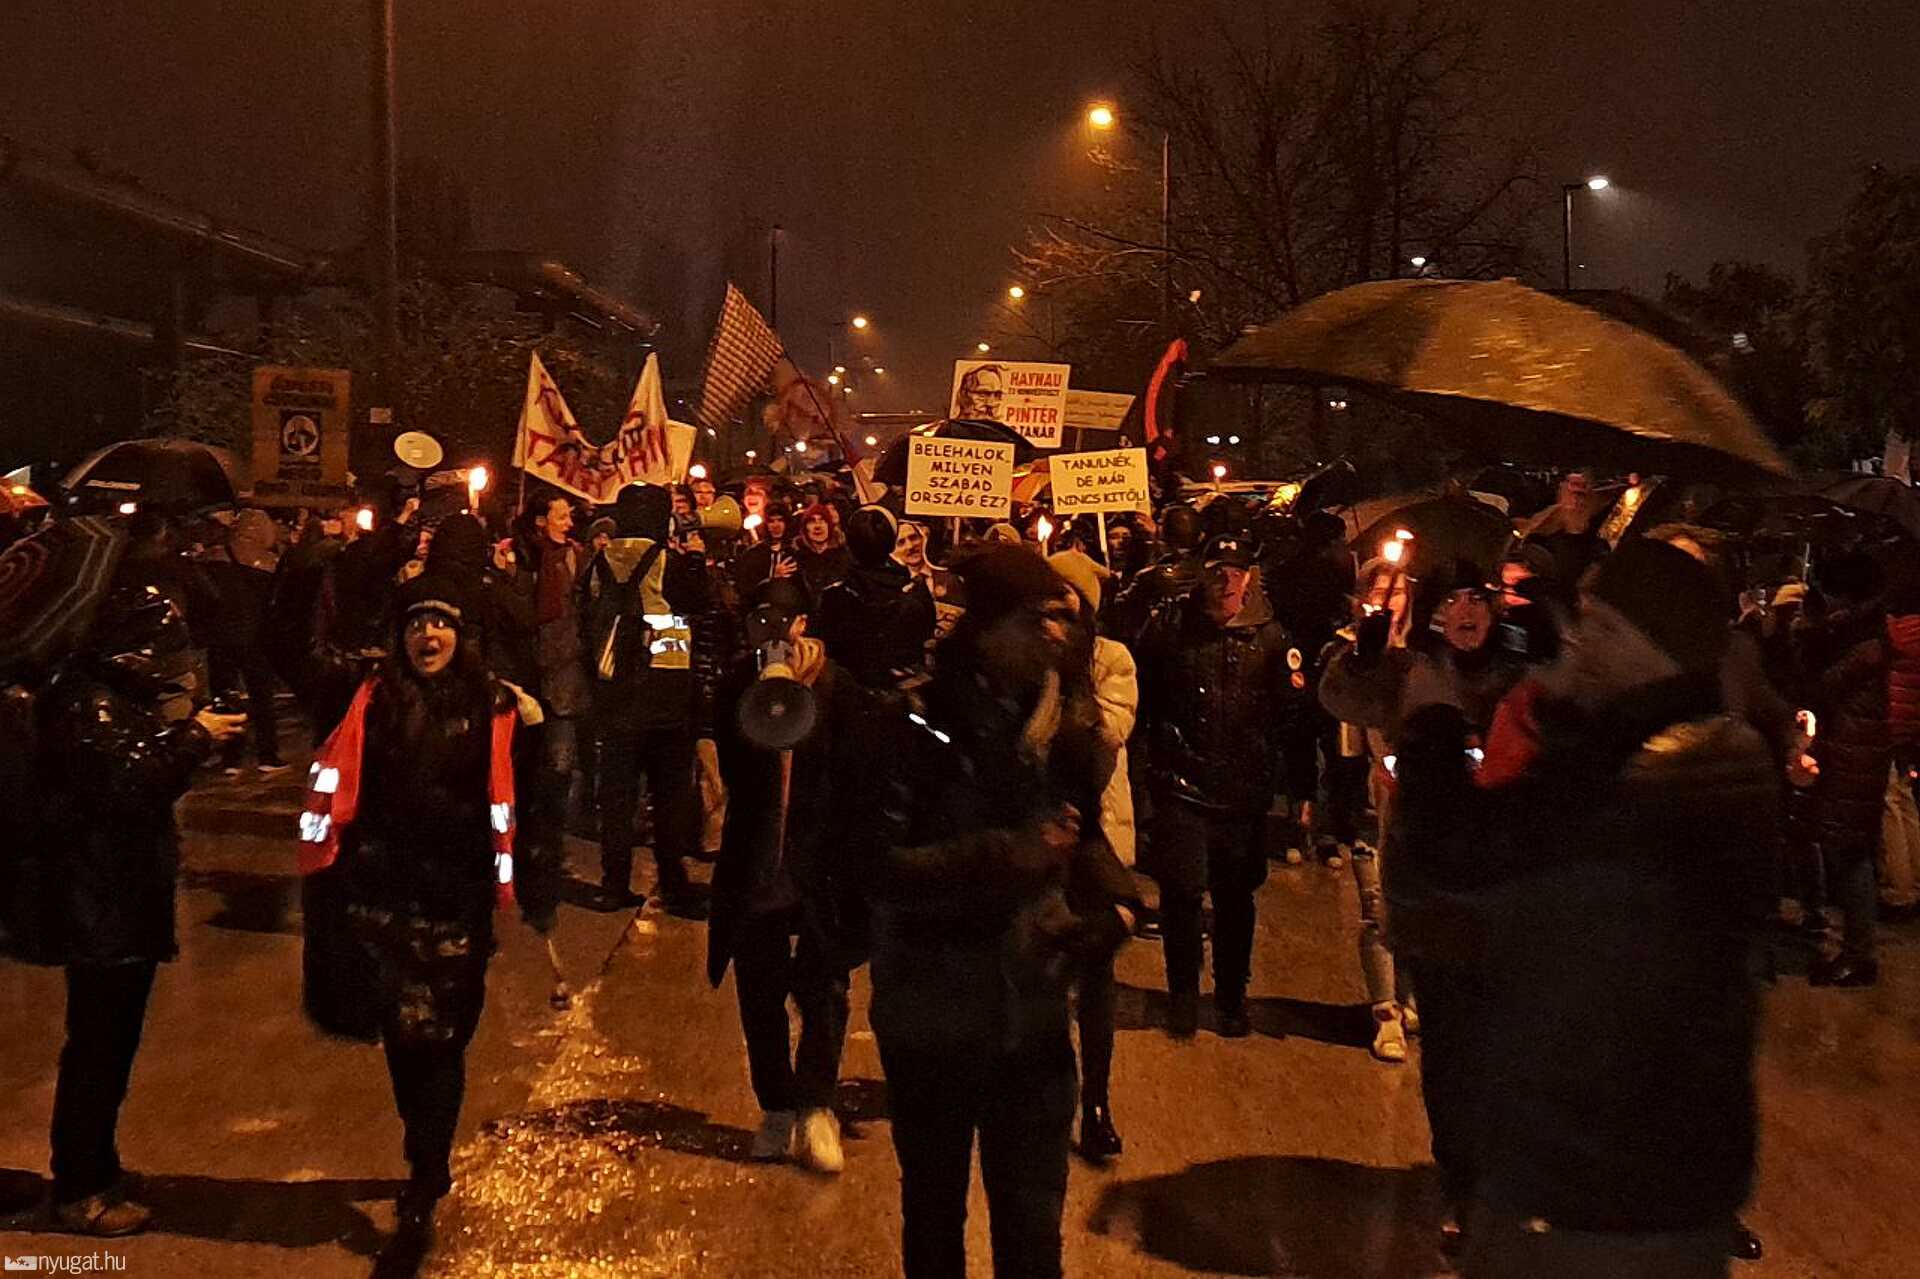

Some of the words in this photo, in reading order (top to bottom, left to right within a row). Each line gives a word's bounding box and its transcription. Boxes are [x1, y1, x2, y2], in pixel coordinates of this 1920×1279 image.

[1006, 404, 1059, 424] PINTÉR
[931, 461, 993, 475] MILYEN
[928, 476, 992, 491] SZABAD
[1077, 475, 1093, 487] DE
[1098, 471, 1125, 485] MÁR
[910, 491, 974, 506] ORSZÁG
[980, 495, 1008, 508] EZ?
[1057, 493, 1101, 507] NINCS
